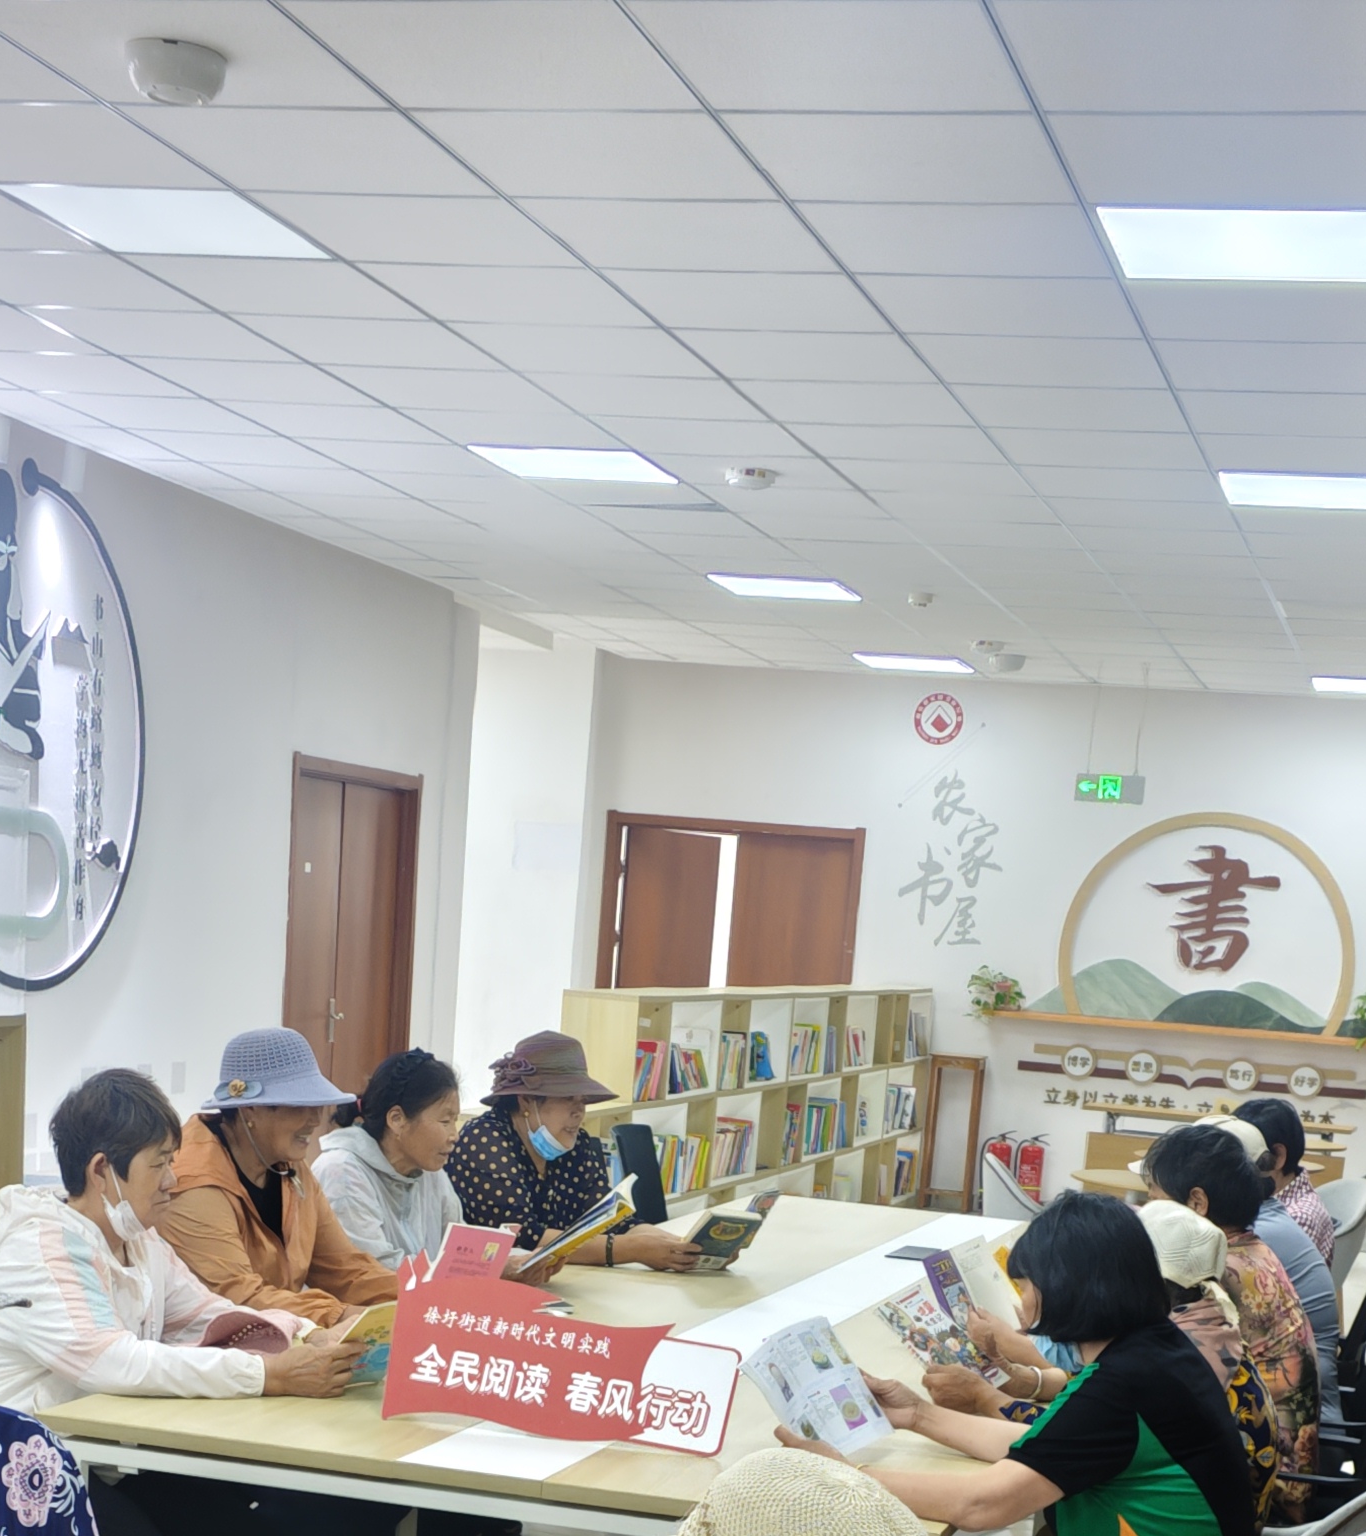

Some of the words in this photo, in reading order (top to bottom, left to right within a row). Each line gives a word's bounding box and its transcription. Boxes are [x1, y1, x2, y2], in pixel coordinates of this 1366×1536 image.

[898, 770, 1003, 948] 农家书屋
[1147, 845, 1282, 973] 書
[423, 1306, 611, 1360] 徐圩街道新时代文明实践
[409, 1343, 552, 1409] 全民阅读
[563, 1370, 712, 1440] 春风行动
